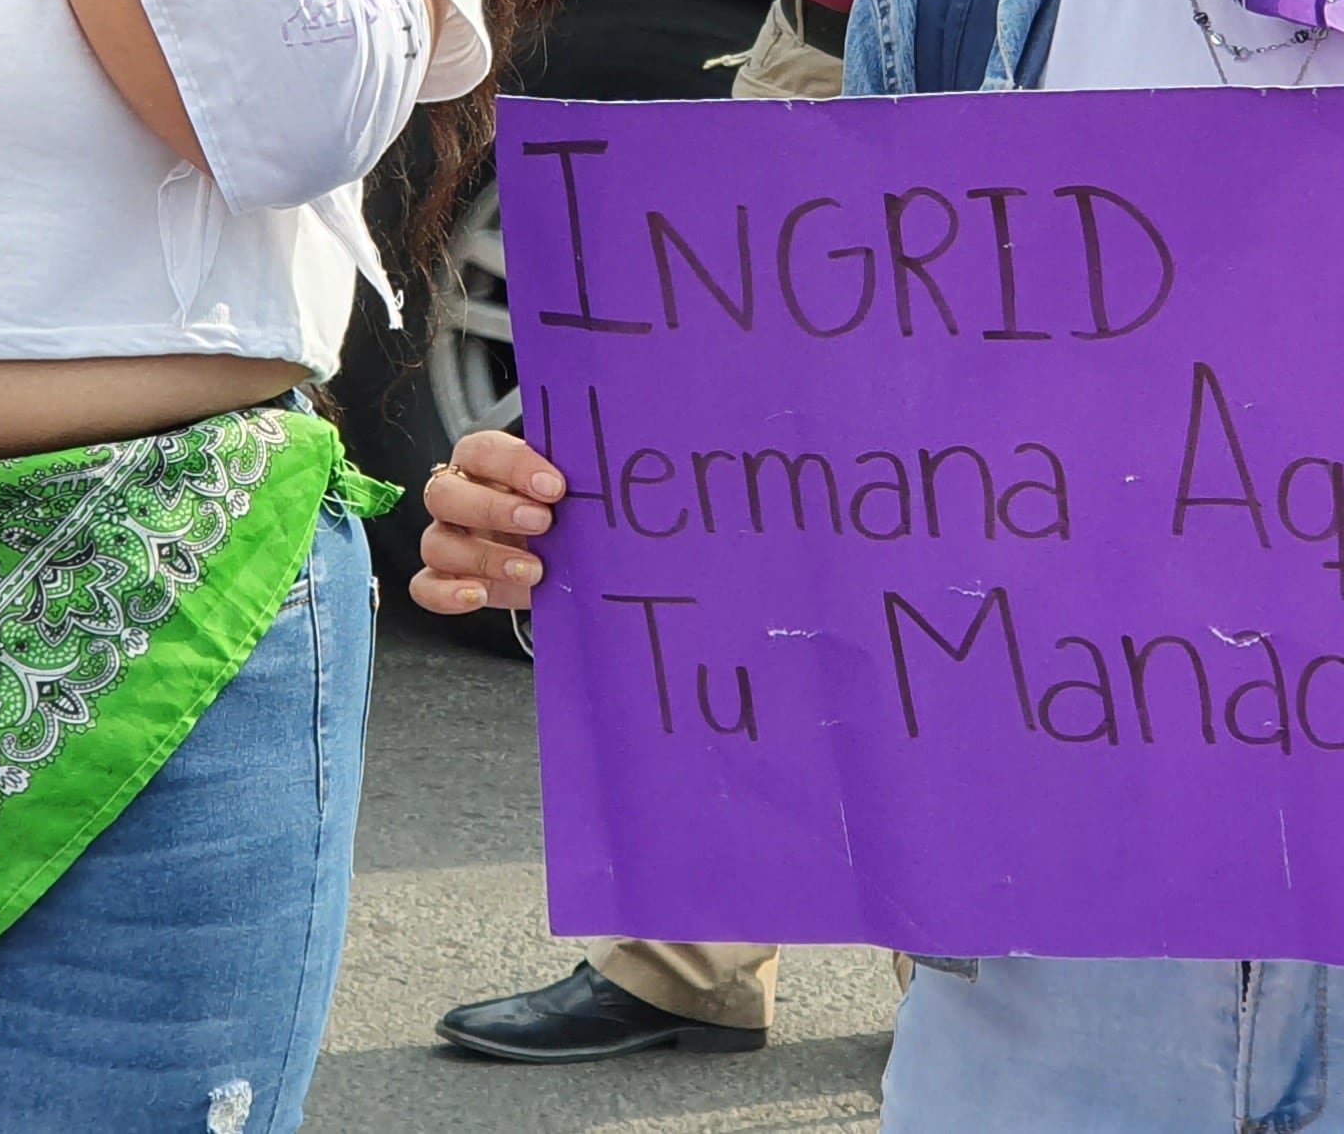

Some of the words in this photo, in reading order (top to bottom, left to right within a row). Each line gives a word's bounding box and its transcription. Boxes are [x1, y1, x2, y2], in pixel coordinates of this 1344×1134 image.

[522, 139, 1174, 341] INGRID
[540, 385, 1071, 541] Hermana
[601, 594, 759, 742] Tu
